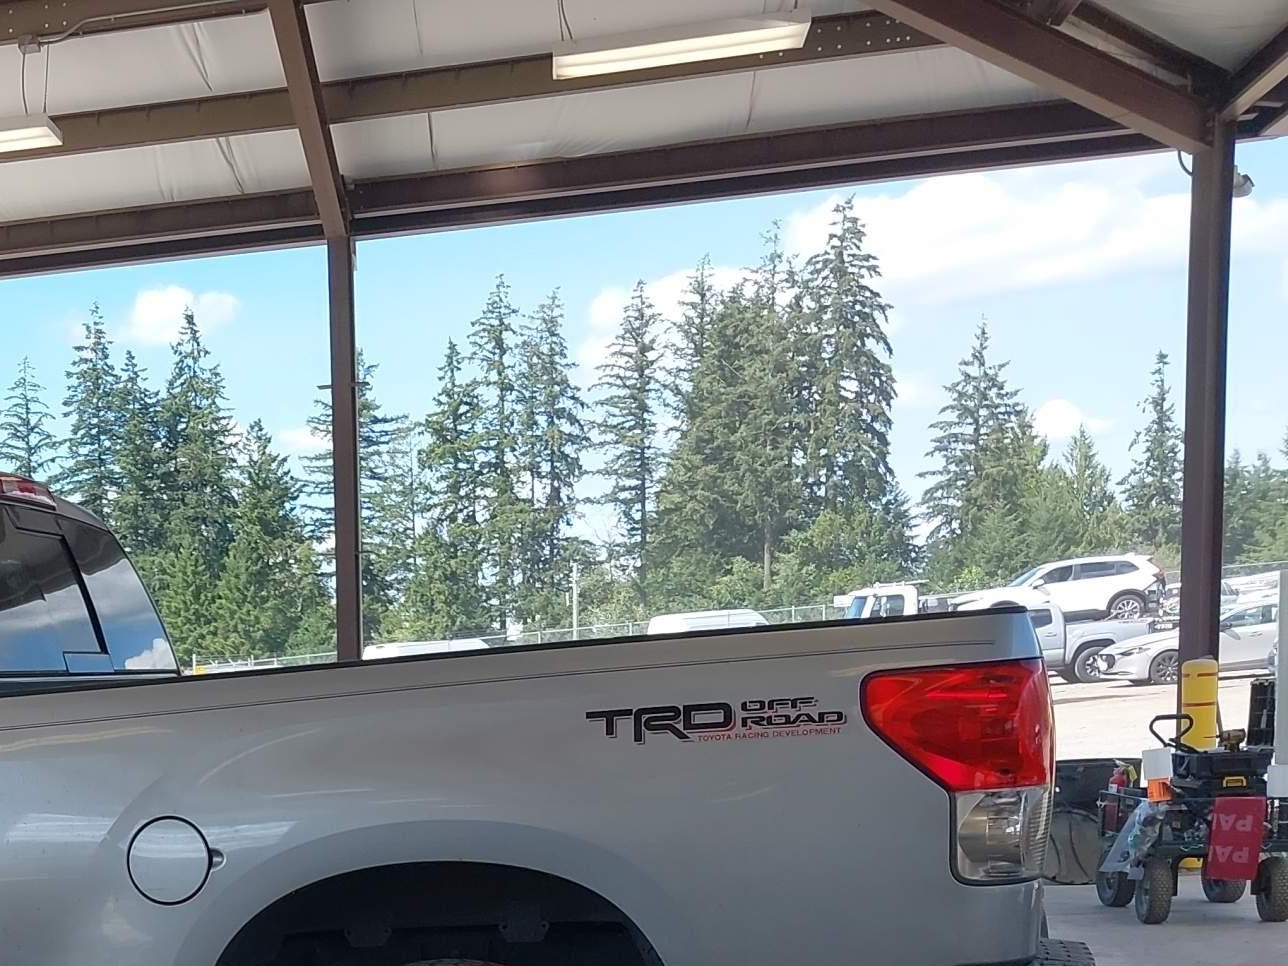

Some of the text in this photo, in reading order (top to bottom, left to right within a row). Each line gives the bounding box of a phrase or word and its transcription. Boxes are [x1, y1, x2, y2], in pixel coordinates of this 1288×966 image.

[740, 696, 818, 714] OFF
[585, 701, 736, 744] TRD
[740, 710, 846, 729] ROAD
[696, 727, 841, 742] TOYOTA RACING DEVELOPMENT
